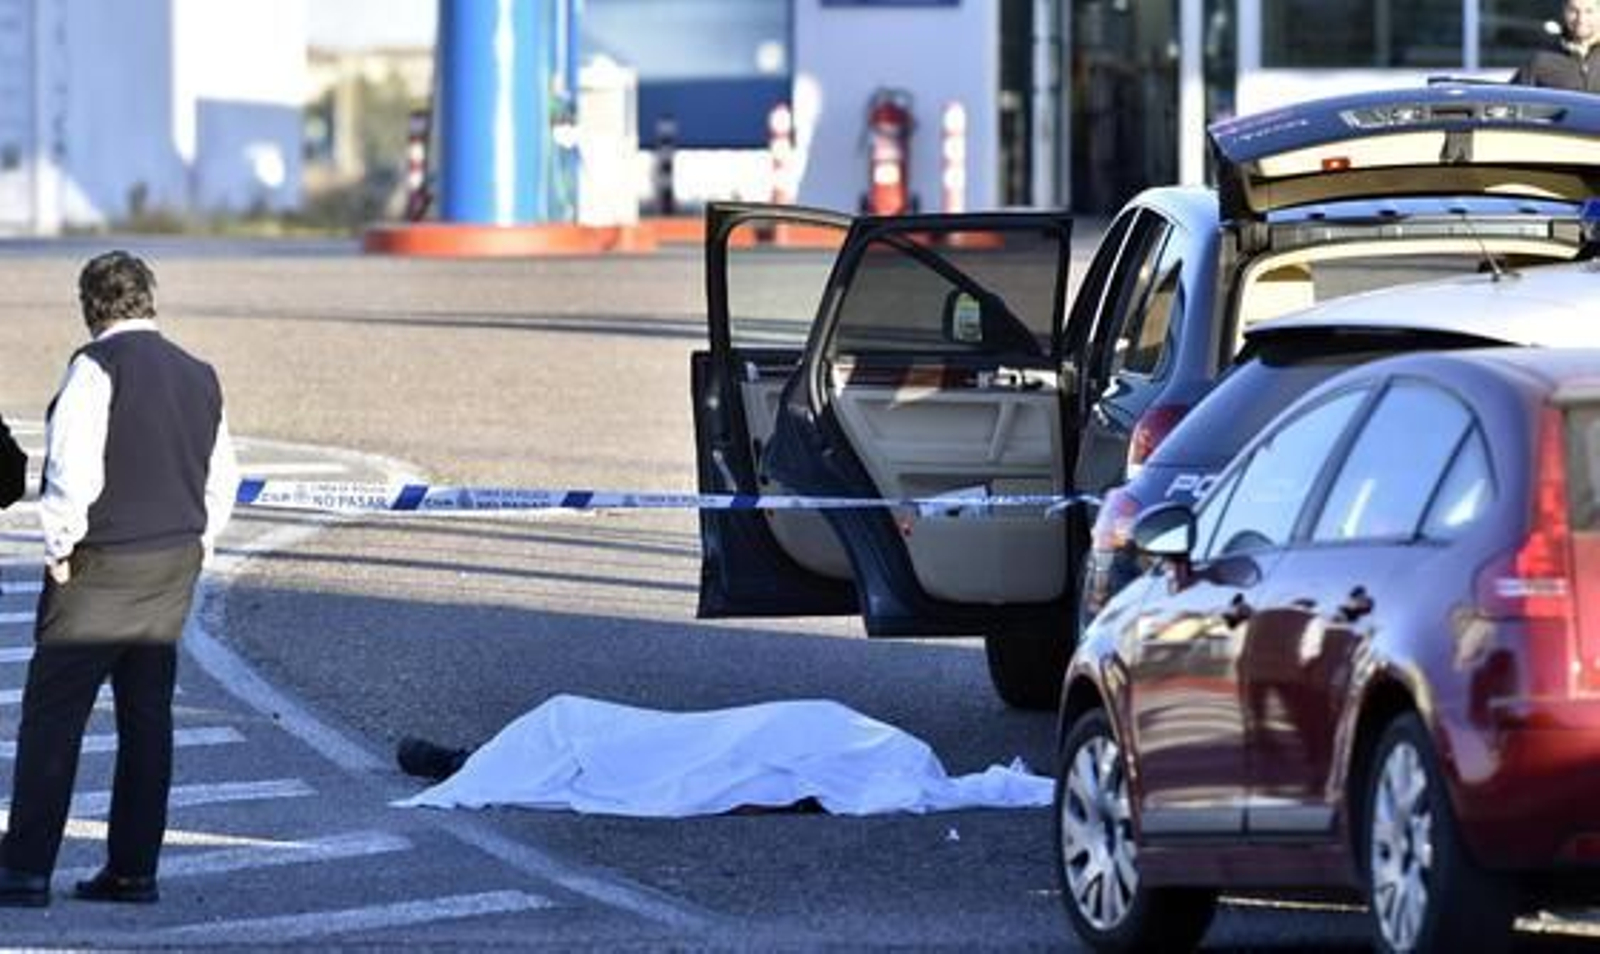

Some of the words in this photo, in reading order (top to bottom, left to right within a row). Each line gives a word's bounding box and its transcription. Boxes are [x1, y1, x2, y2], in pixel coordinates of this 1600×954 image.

[1165, 474, 1223, 498] PO
[313, 493, 335, 508] NO
[338, 494, 388, 510] PASAR
